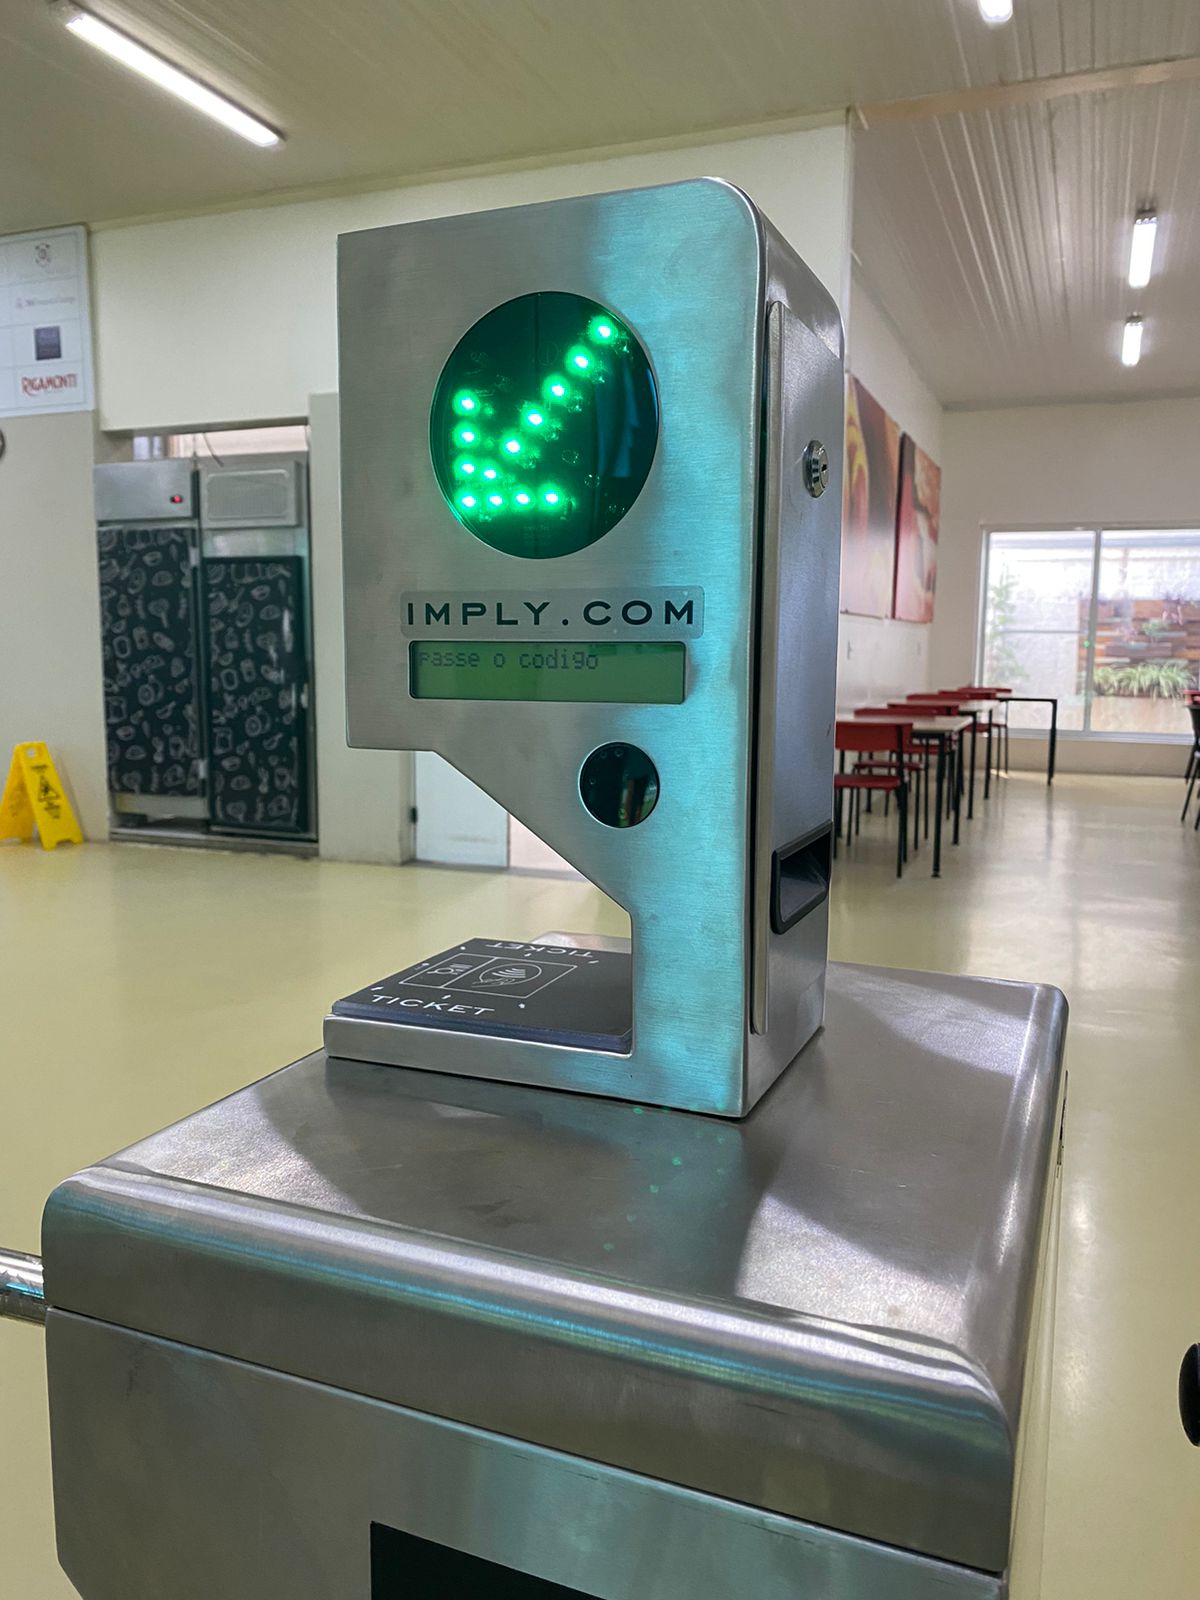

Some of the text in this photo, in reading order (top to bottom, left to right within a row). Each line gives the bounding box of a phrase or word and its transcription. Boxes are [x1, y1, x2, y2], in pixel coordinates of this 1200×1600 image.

[21, 373, 78, 396] RIGAMONTI
[407, 599, 694, 626] IMPLY.COM
[518, 648, 599, 670] codigo
[485, 942, 593, 958] TICKET
[371, 994, 495, 1015] TICKET
